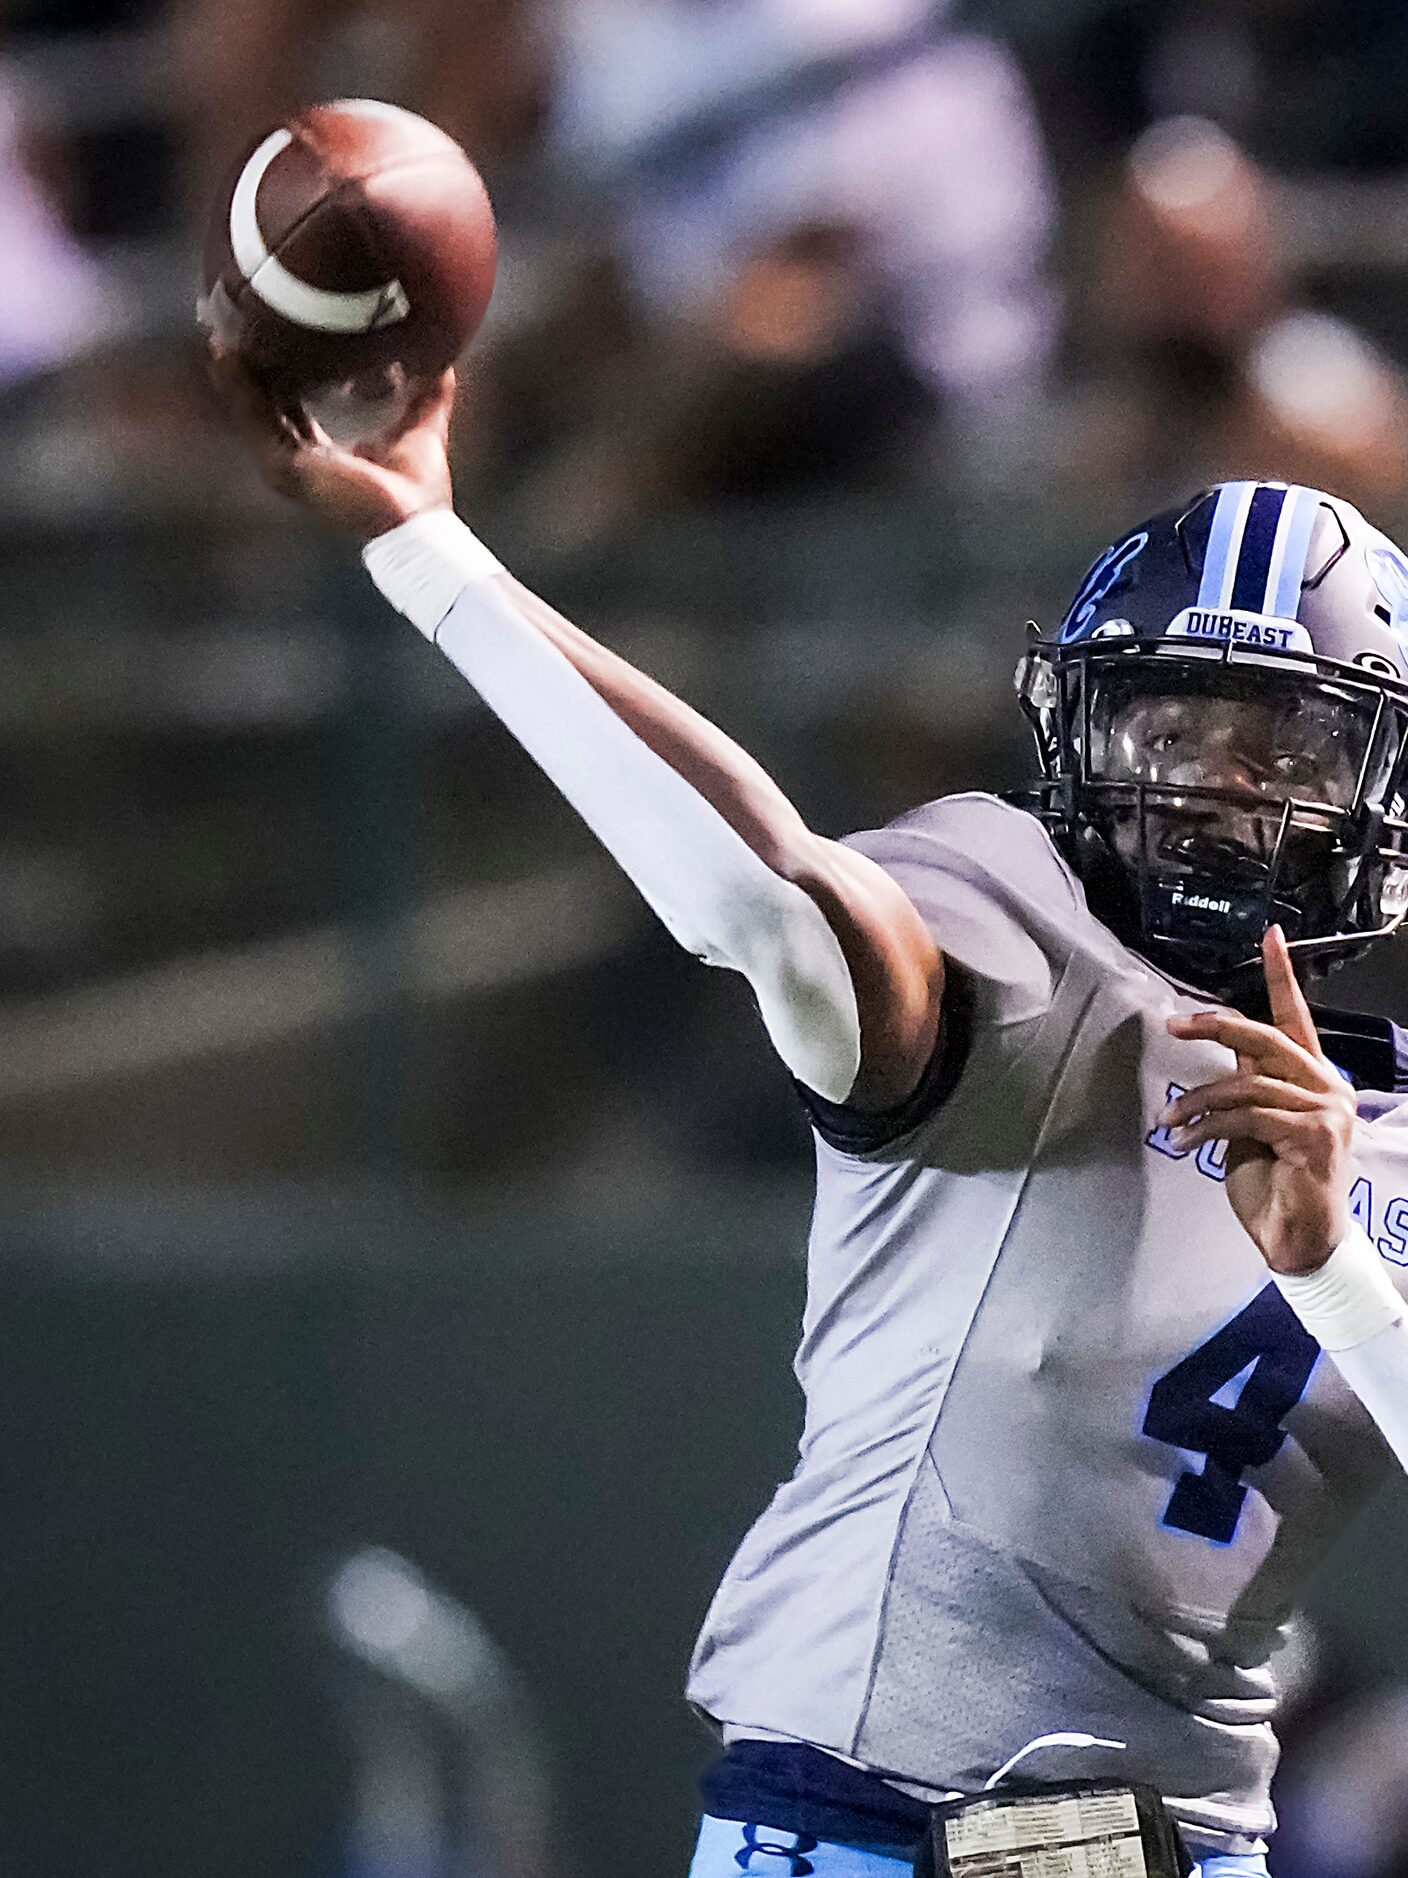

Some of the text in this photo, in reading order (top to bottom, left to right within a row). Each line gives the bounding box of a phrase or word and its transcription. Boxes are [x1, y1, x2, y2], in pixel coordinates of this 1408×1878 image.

[1186, 611, 1294, 649] DUBEAST
[1171, 892, 1231, 914] Riddell
[1133, 1276, 1322, 1547] 4
